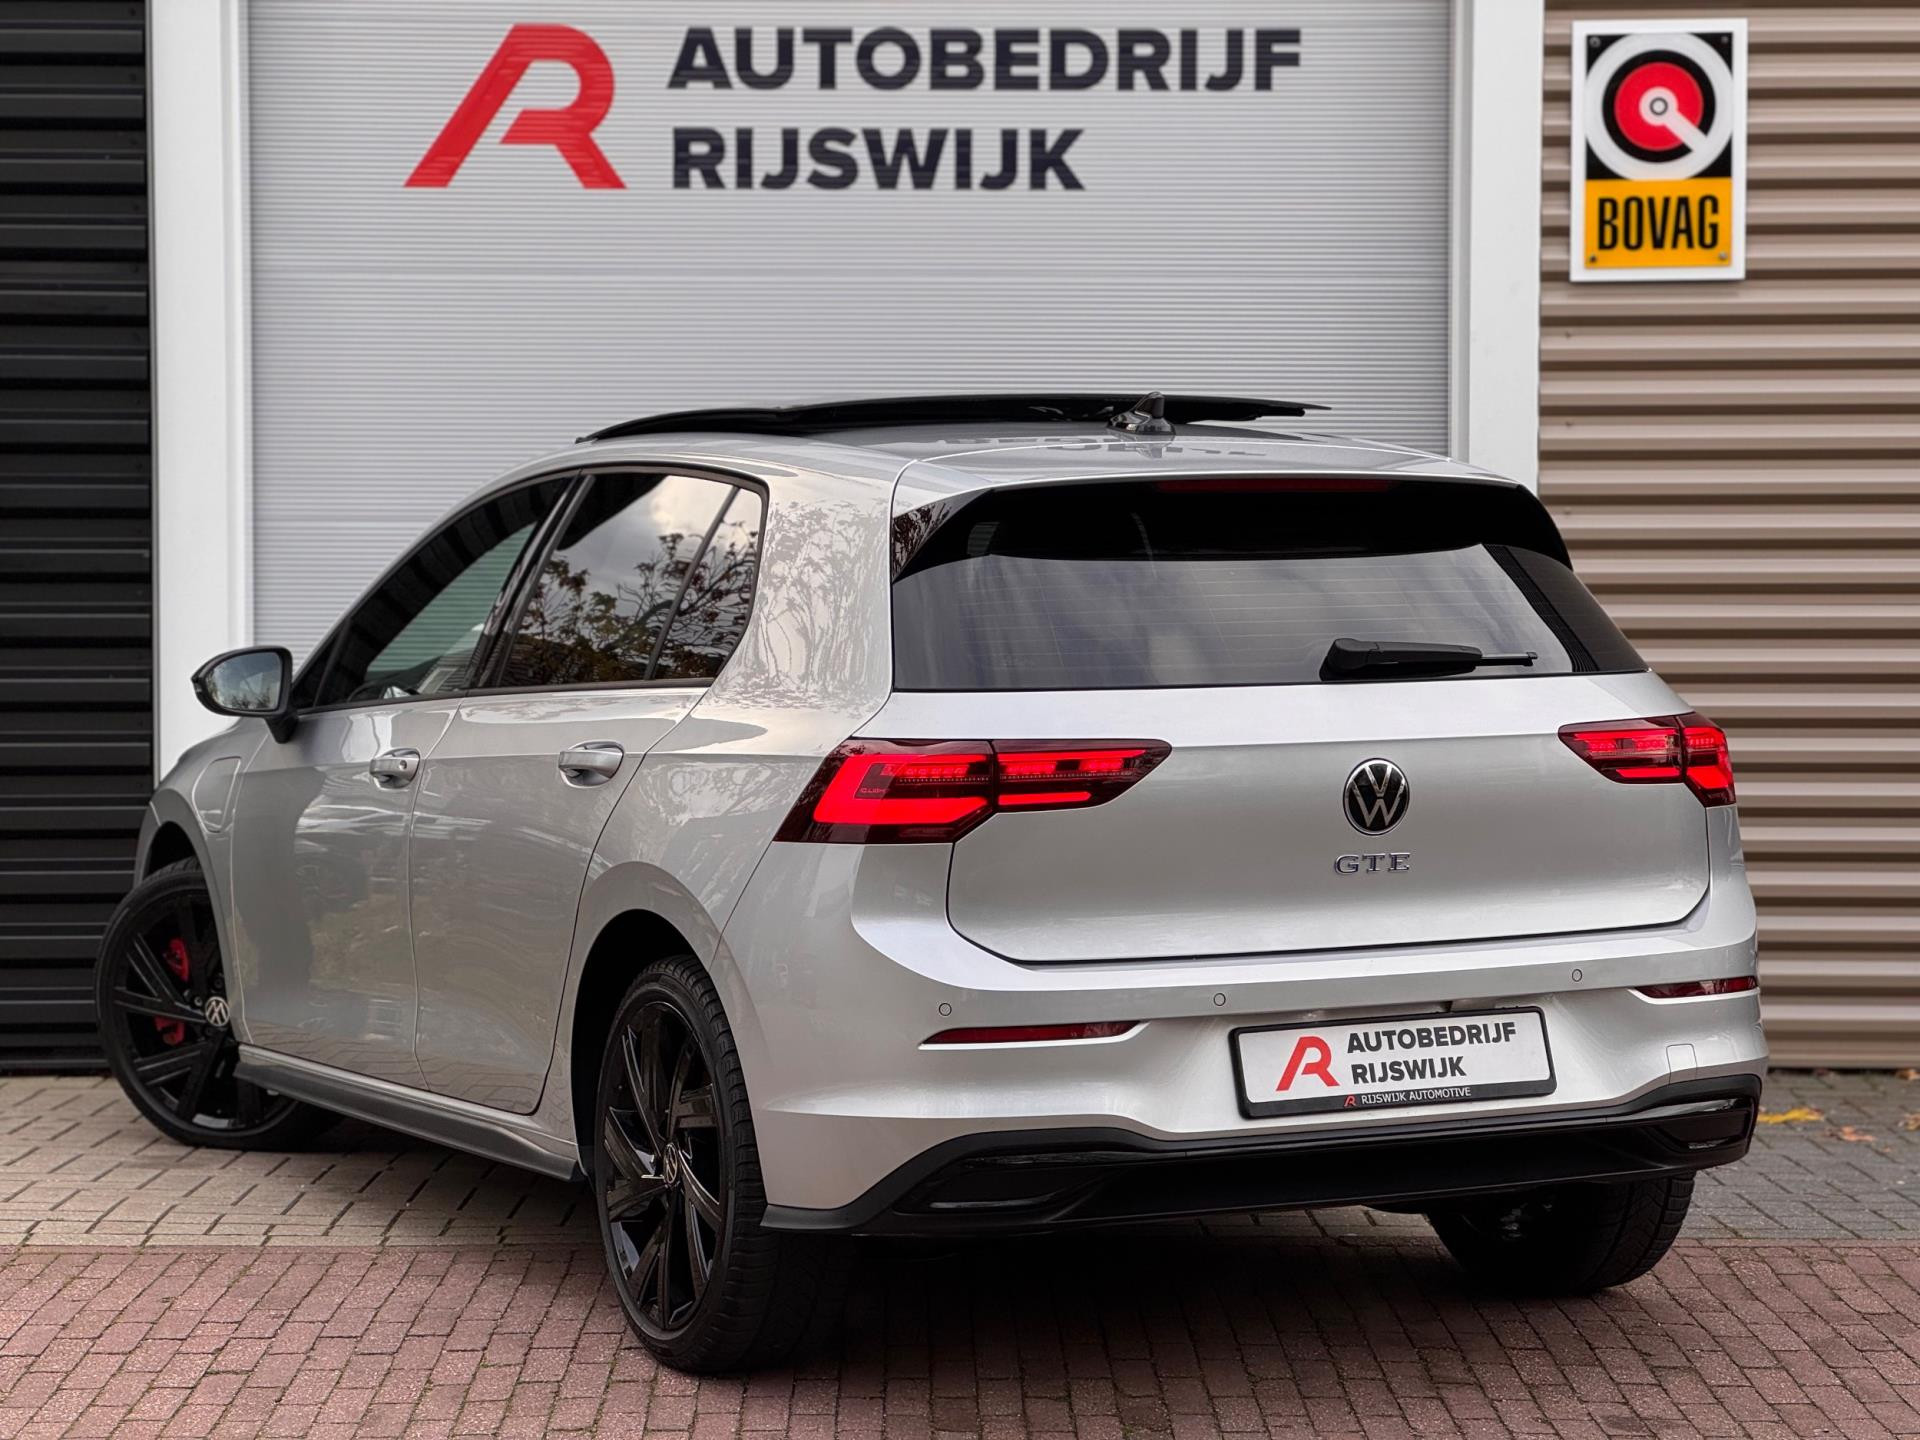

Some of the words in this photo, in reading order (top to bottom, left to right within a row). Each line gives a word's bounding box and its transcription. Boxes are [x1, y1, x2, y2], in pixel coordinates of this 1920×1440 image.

[667, 27, 1300, 92] AUTOBEDRIJF
[672, 127, 1086, 191] RIJSWIJK
[1597, 194, 1720, 250] BOVAG
[1334, 852, 1411, 874] GTE
[1347, 1022, 1516, 1053] AUTOBEDRIJF
[1351, 1057, 1466, 1084] RIJSWIJK
[1361, 1091, 1407, 1105] RIJSWIJK
[1409, 1086, 1472, 1101] AUTOMOTIVE
